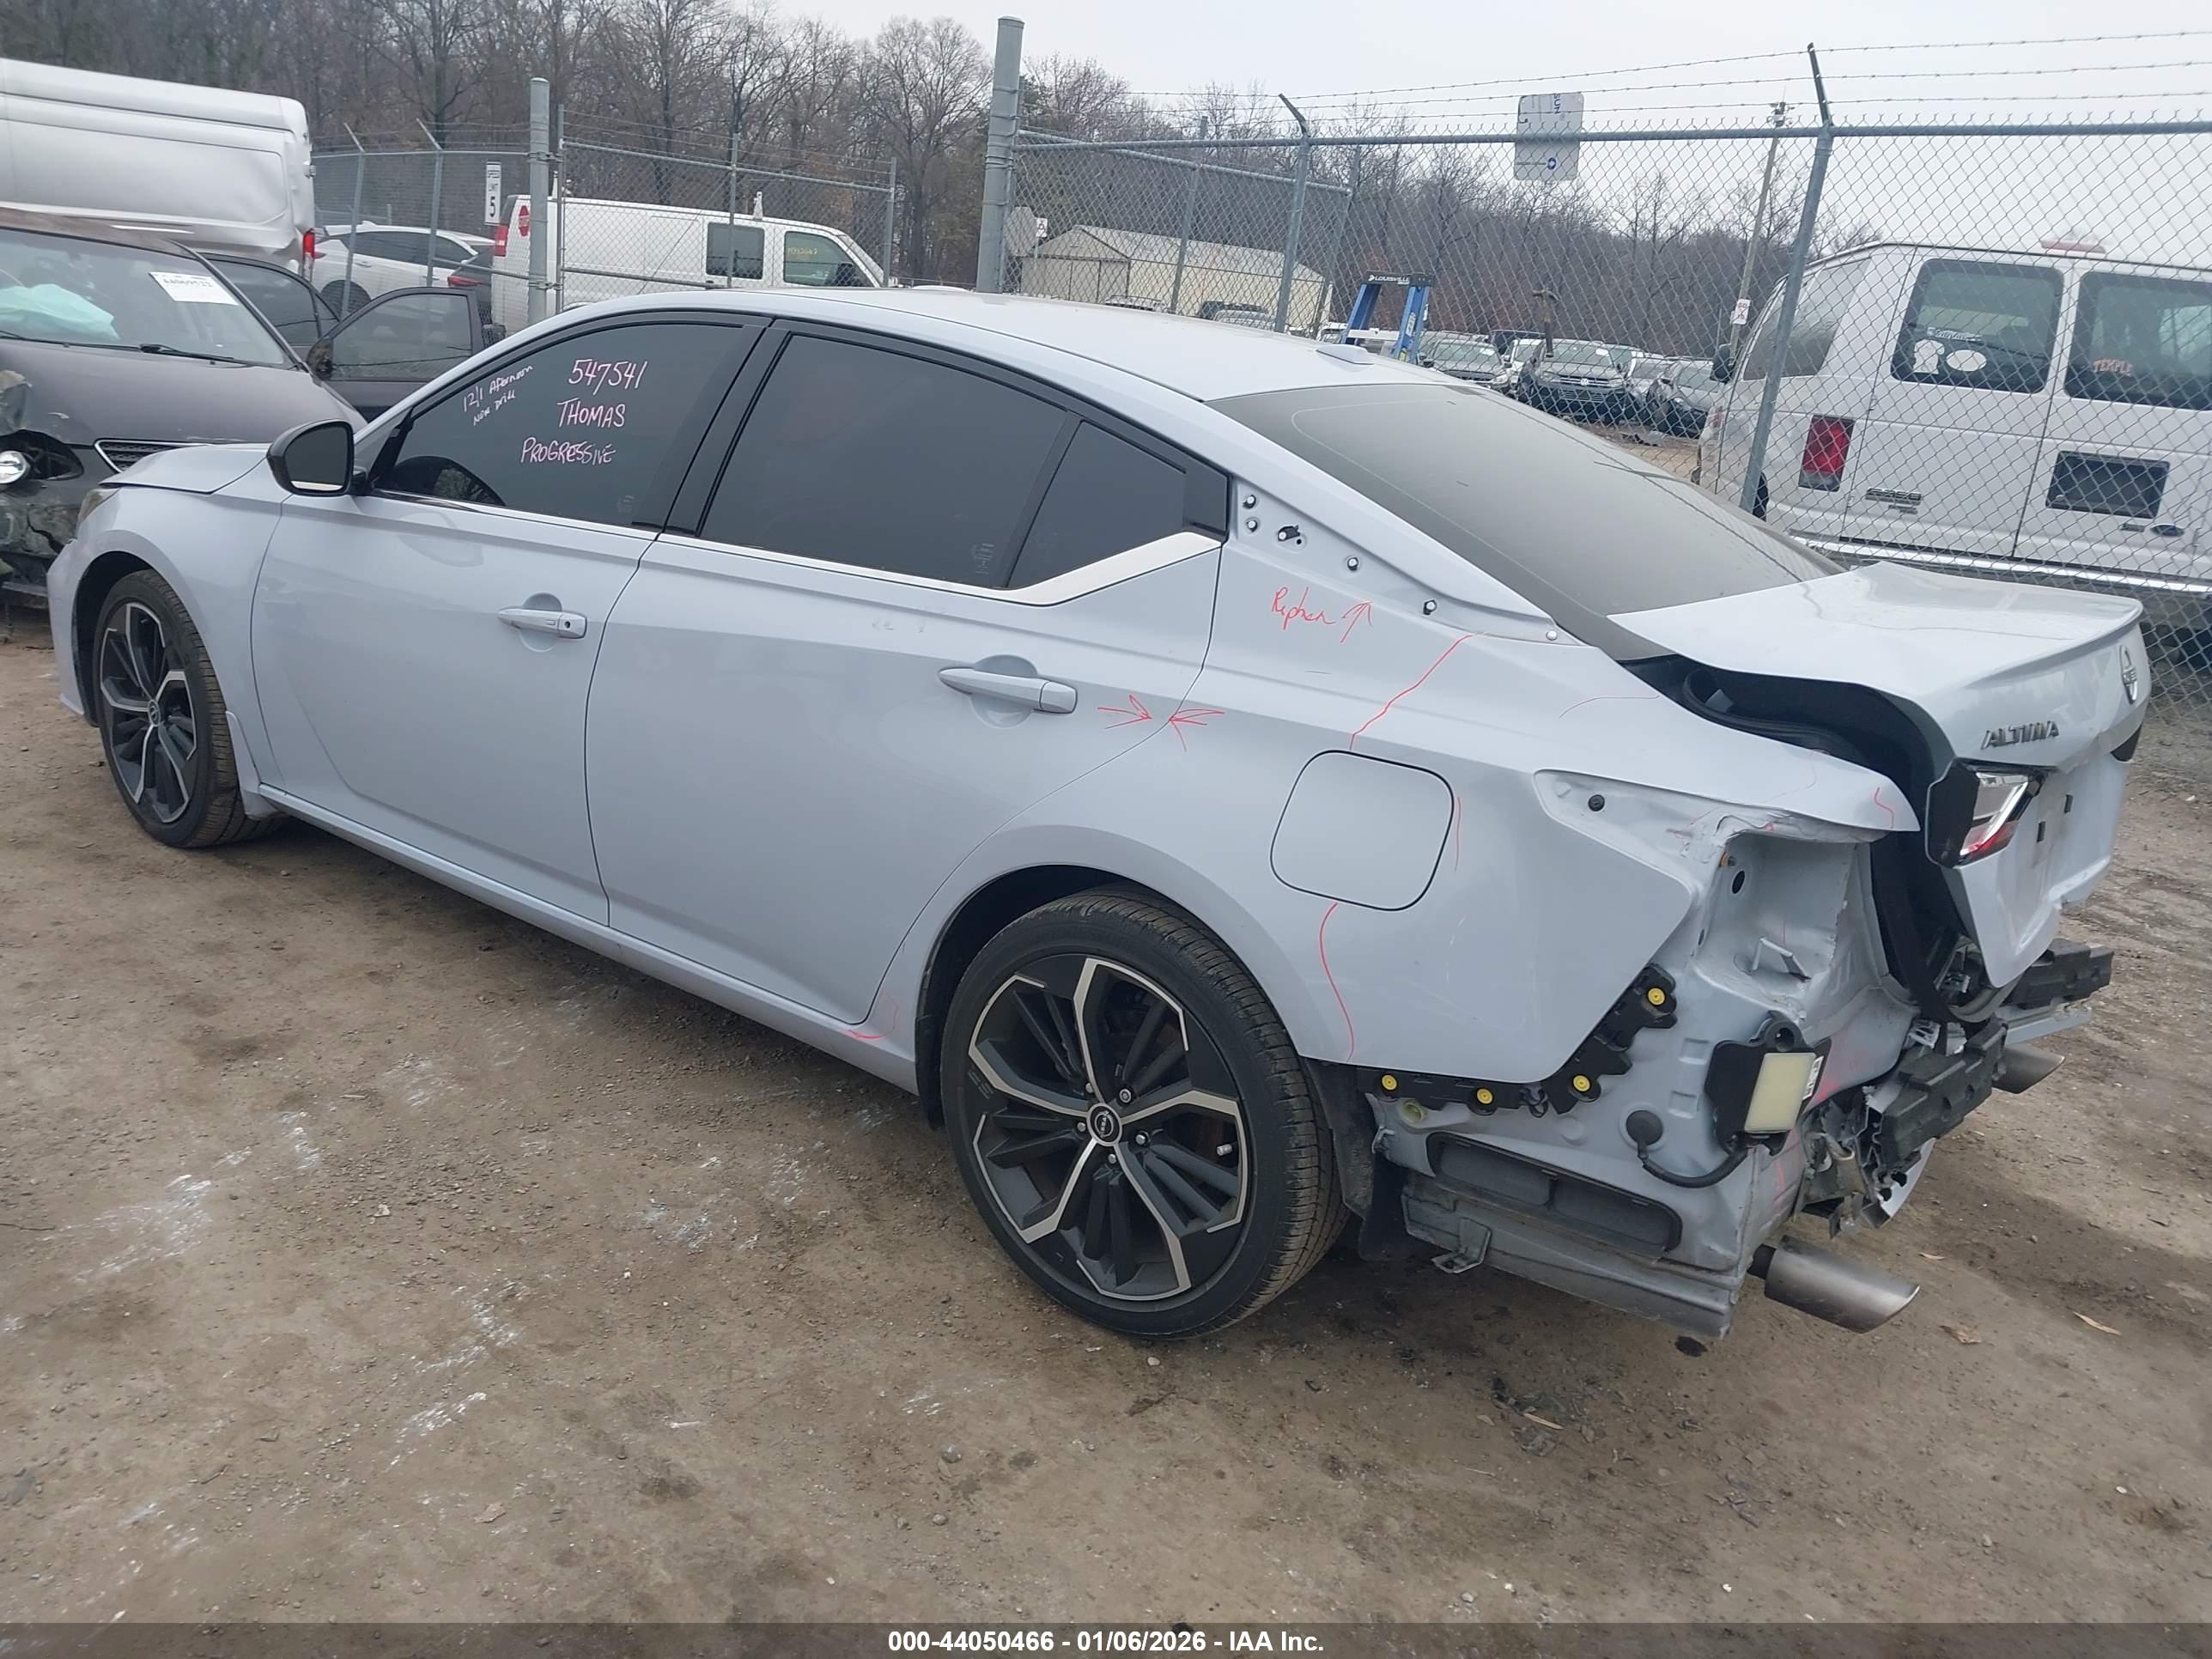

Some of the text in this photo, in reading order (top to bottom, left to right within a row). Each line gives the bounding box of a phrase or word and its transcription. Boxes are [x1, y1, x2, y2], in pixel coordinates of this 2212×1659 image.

[489, 196, 496, 217] 5
[568, 359, 648, 395] 547541
[464, 386, 483, 413] 12/1
[556, 398, 626, 428] THOMAS
[520, 436, 617, 465] PROGRESSIVE
[1980, 720, 2060, 750] ALTIMA
